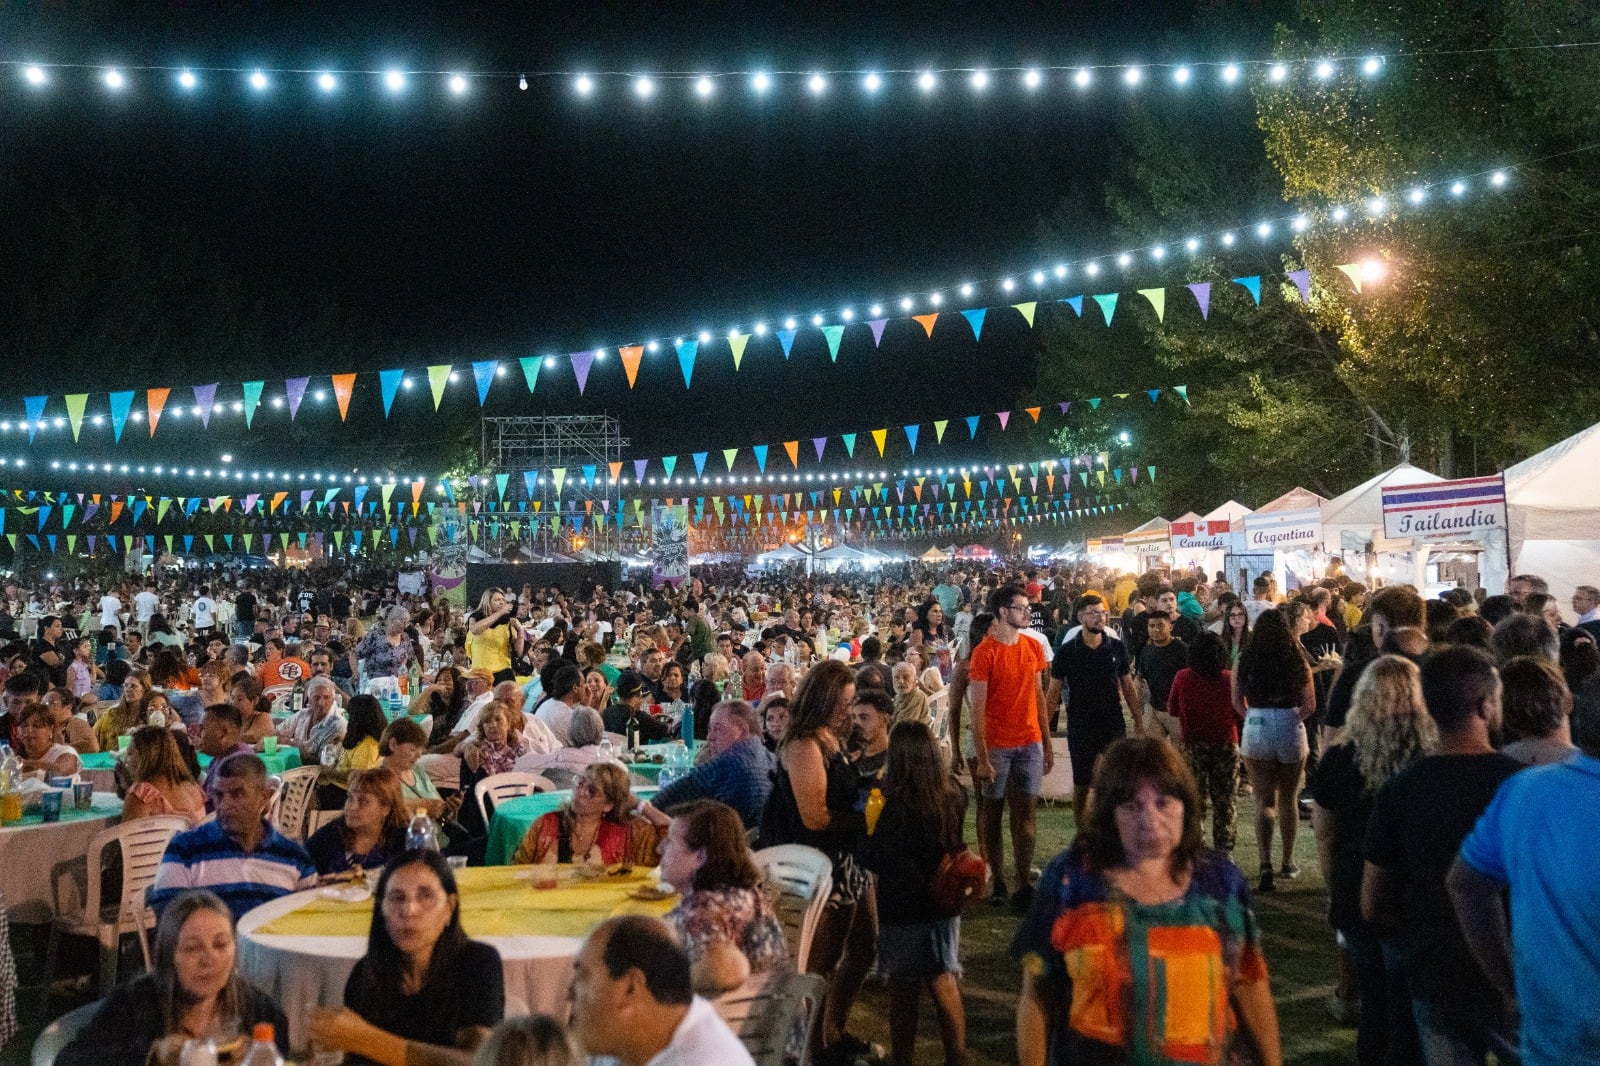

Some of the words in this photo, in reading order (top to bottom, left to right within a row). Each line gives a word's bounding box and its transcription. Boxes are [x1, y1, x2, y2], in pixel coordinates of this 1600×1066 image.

[1399, 508, 1497, 533] Tailandia
[1179, 536, 1224, 548] Canadá
[1253, 528, 1315, 545] Argentina
[1136, 544, 1160, 553] India
[1030, 618, 1044, 626] CIAL
